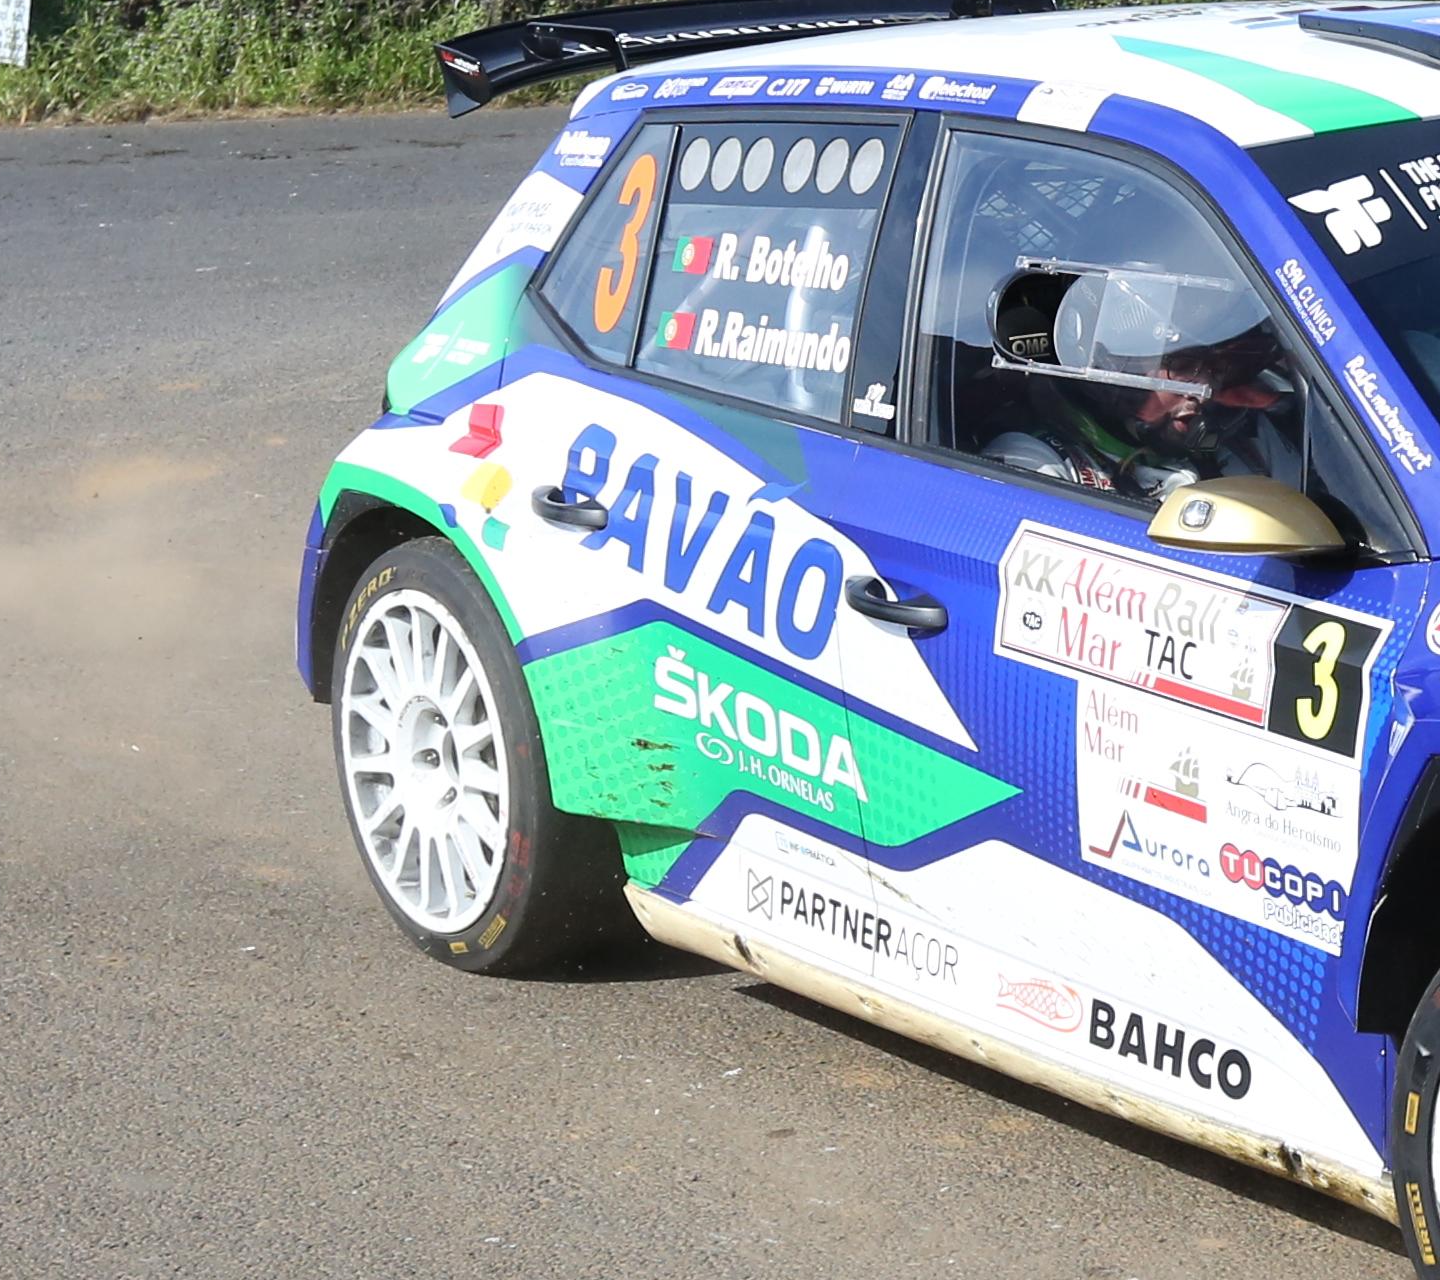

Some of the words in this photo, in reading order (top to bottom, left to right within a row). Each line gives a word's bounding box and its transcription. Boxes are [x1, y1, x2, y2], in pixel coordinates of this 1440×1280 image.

[593, 154, 656, 333] 3
[713, 233, 738, 281] R.
[745, 236, 849, 291] Botelho
[1299, 284, 1337, 342] CLÍNICA
[1012, 336, 1049, 355] OMP
[560, 423, 844, 660] PAVÃO
[1062, 558, 1147, 623] Além
[1153, 582, 1228, 645] Rali
[1057, 606, 1122, 671] Mar
[1145, 629, 1197, 680] TAC
[1295, 620, 1346, 740] 3
[653, 644, 868, 803] ŠKODA
[1085, 688, 1138, 734] Além
[1084, 721, 1126, 763] Mar
[768, 769, 835, 813] ORNELAS
[1226, 800, 1260, 825] Angra
[1265, 814, 1279, 830] do
[1222, 849, 1341, 913] TUCOPI
[1263, 897, 1343, 945] Publicidad
[1089, 998, 1252, 1100] BAHCO
